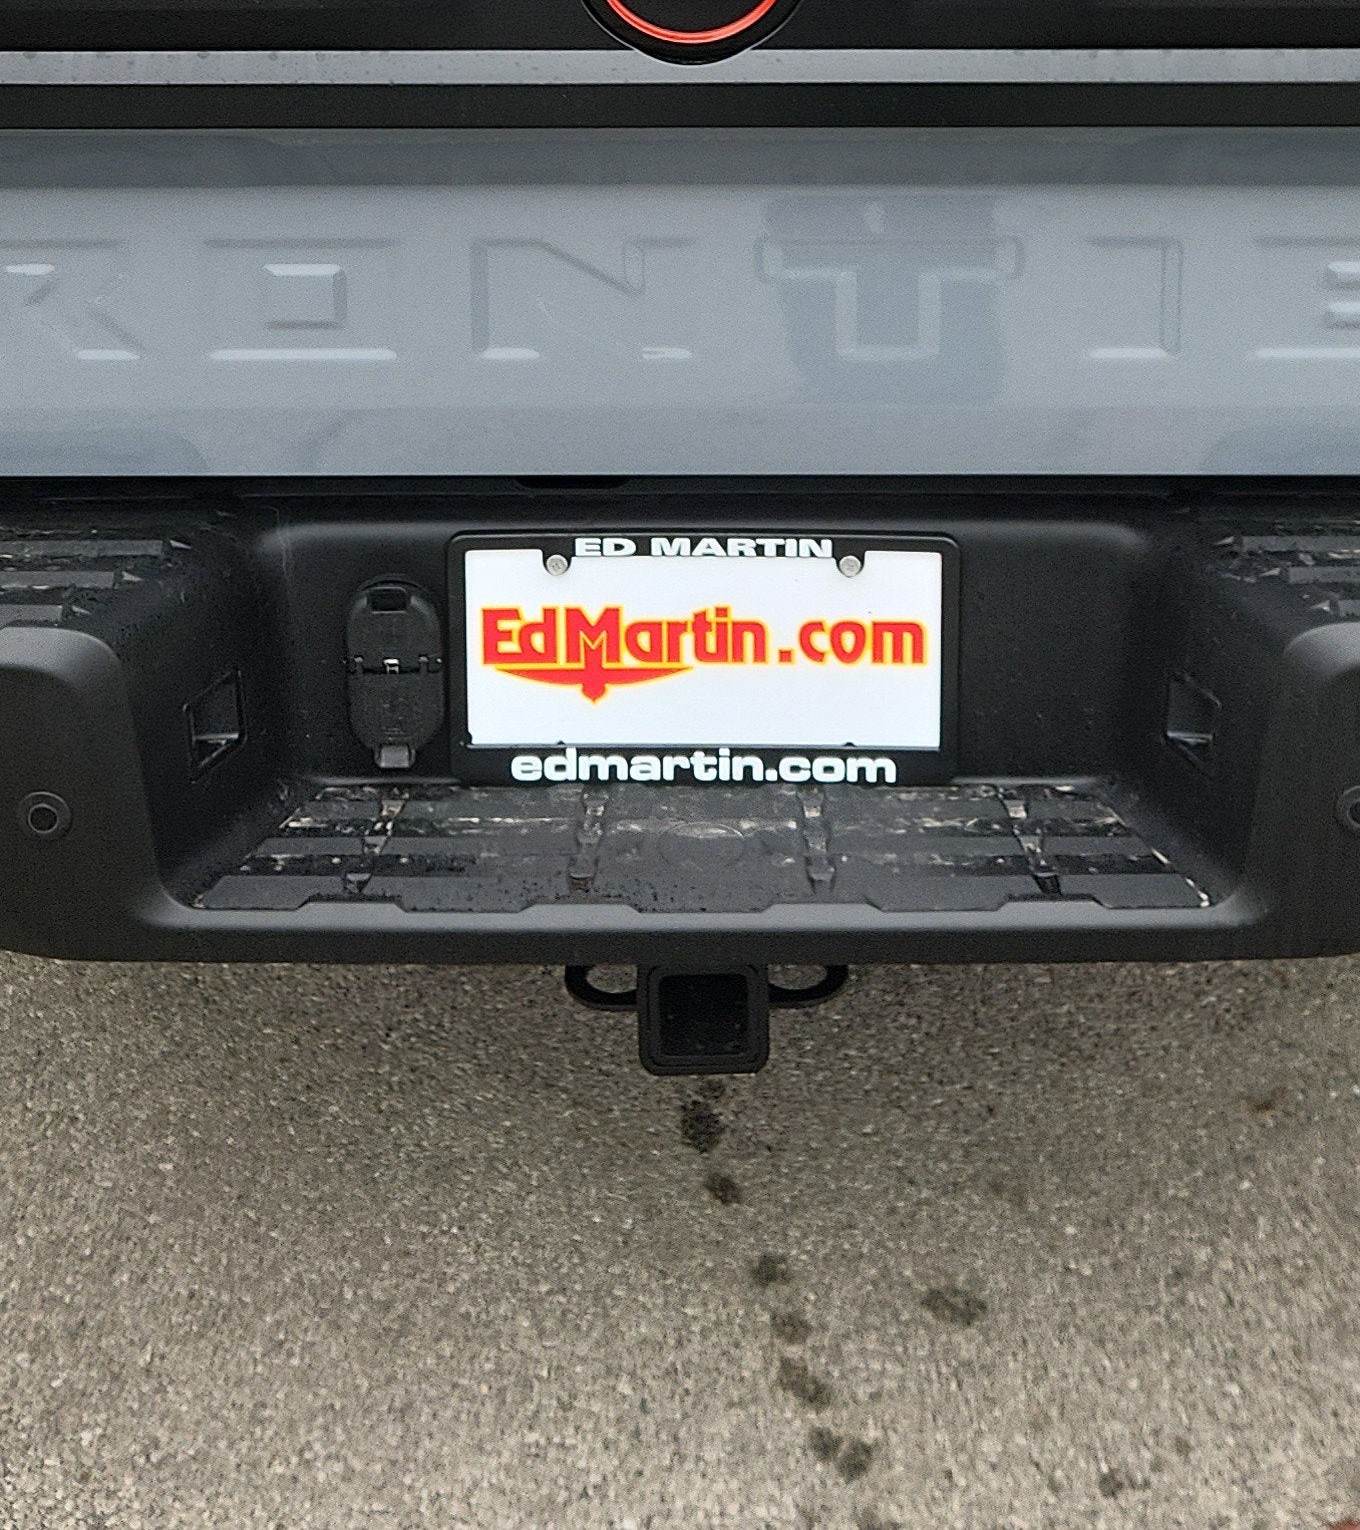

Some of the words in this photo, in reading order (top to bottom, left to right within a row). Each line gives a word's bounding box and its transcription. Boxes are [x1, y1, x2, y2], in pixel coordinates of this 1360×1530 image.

[575, 538, 637, 557] ED
[650, 538, 833, 557] MARTIN
[511, 748, 897, 784] edmartin.com
